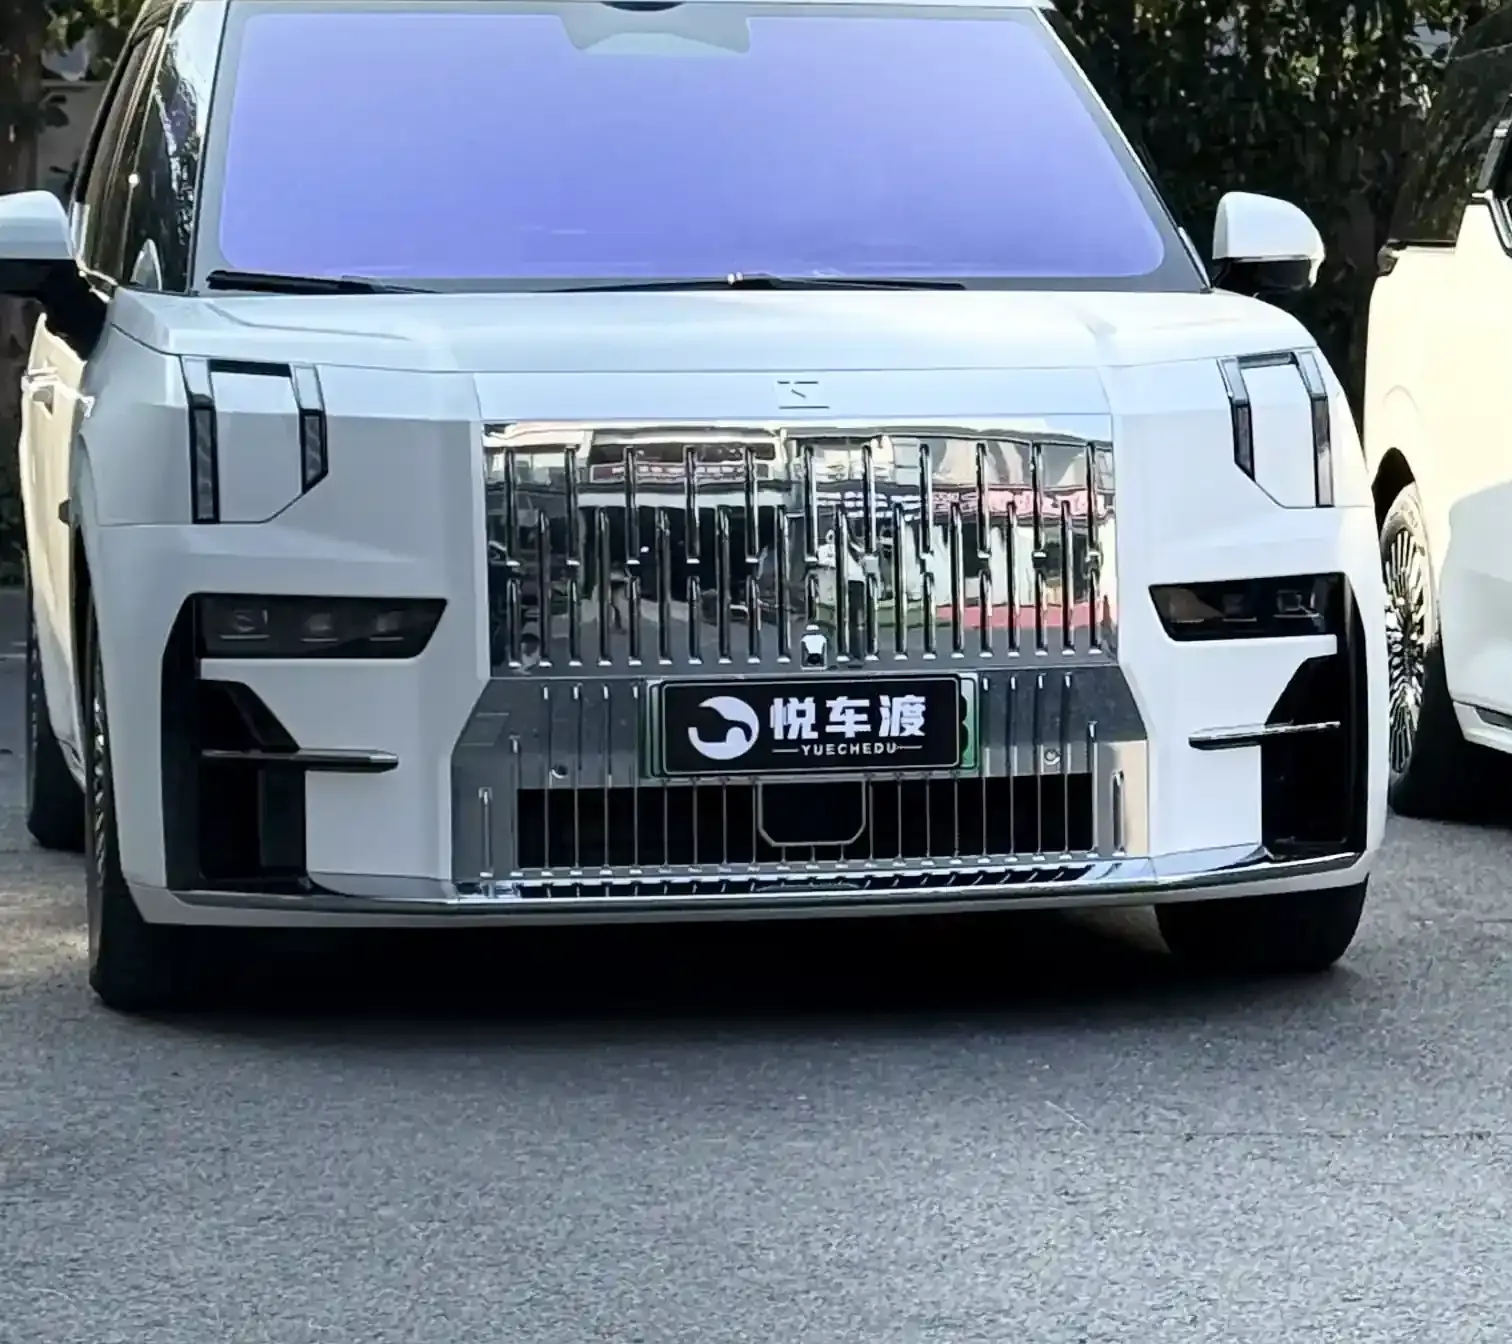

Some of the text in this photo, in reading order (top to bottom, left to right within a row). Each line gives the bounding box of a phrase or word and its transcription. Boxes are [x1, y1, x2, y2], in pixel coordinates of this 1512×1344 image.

[769, 694, 927, 740] 悦车渡
[801, 742, 898, 757] YUECHEDU
